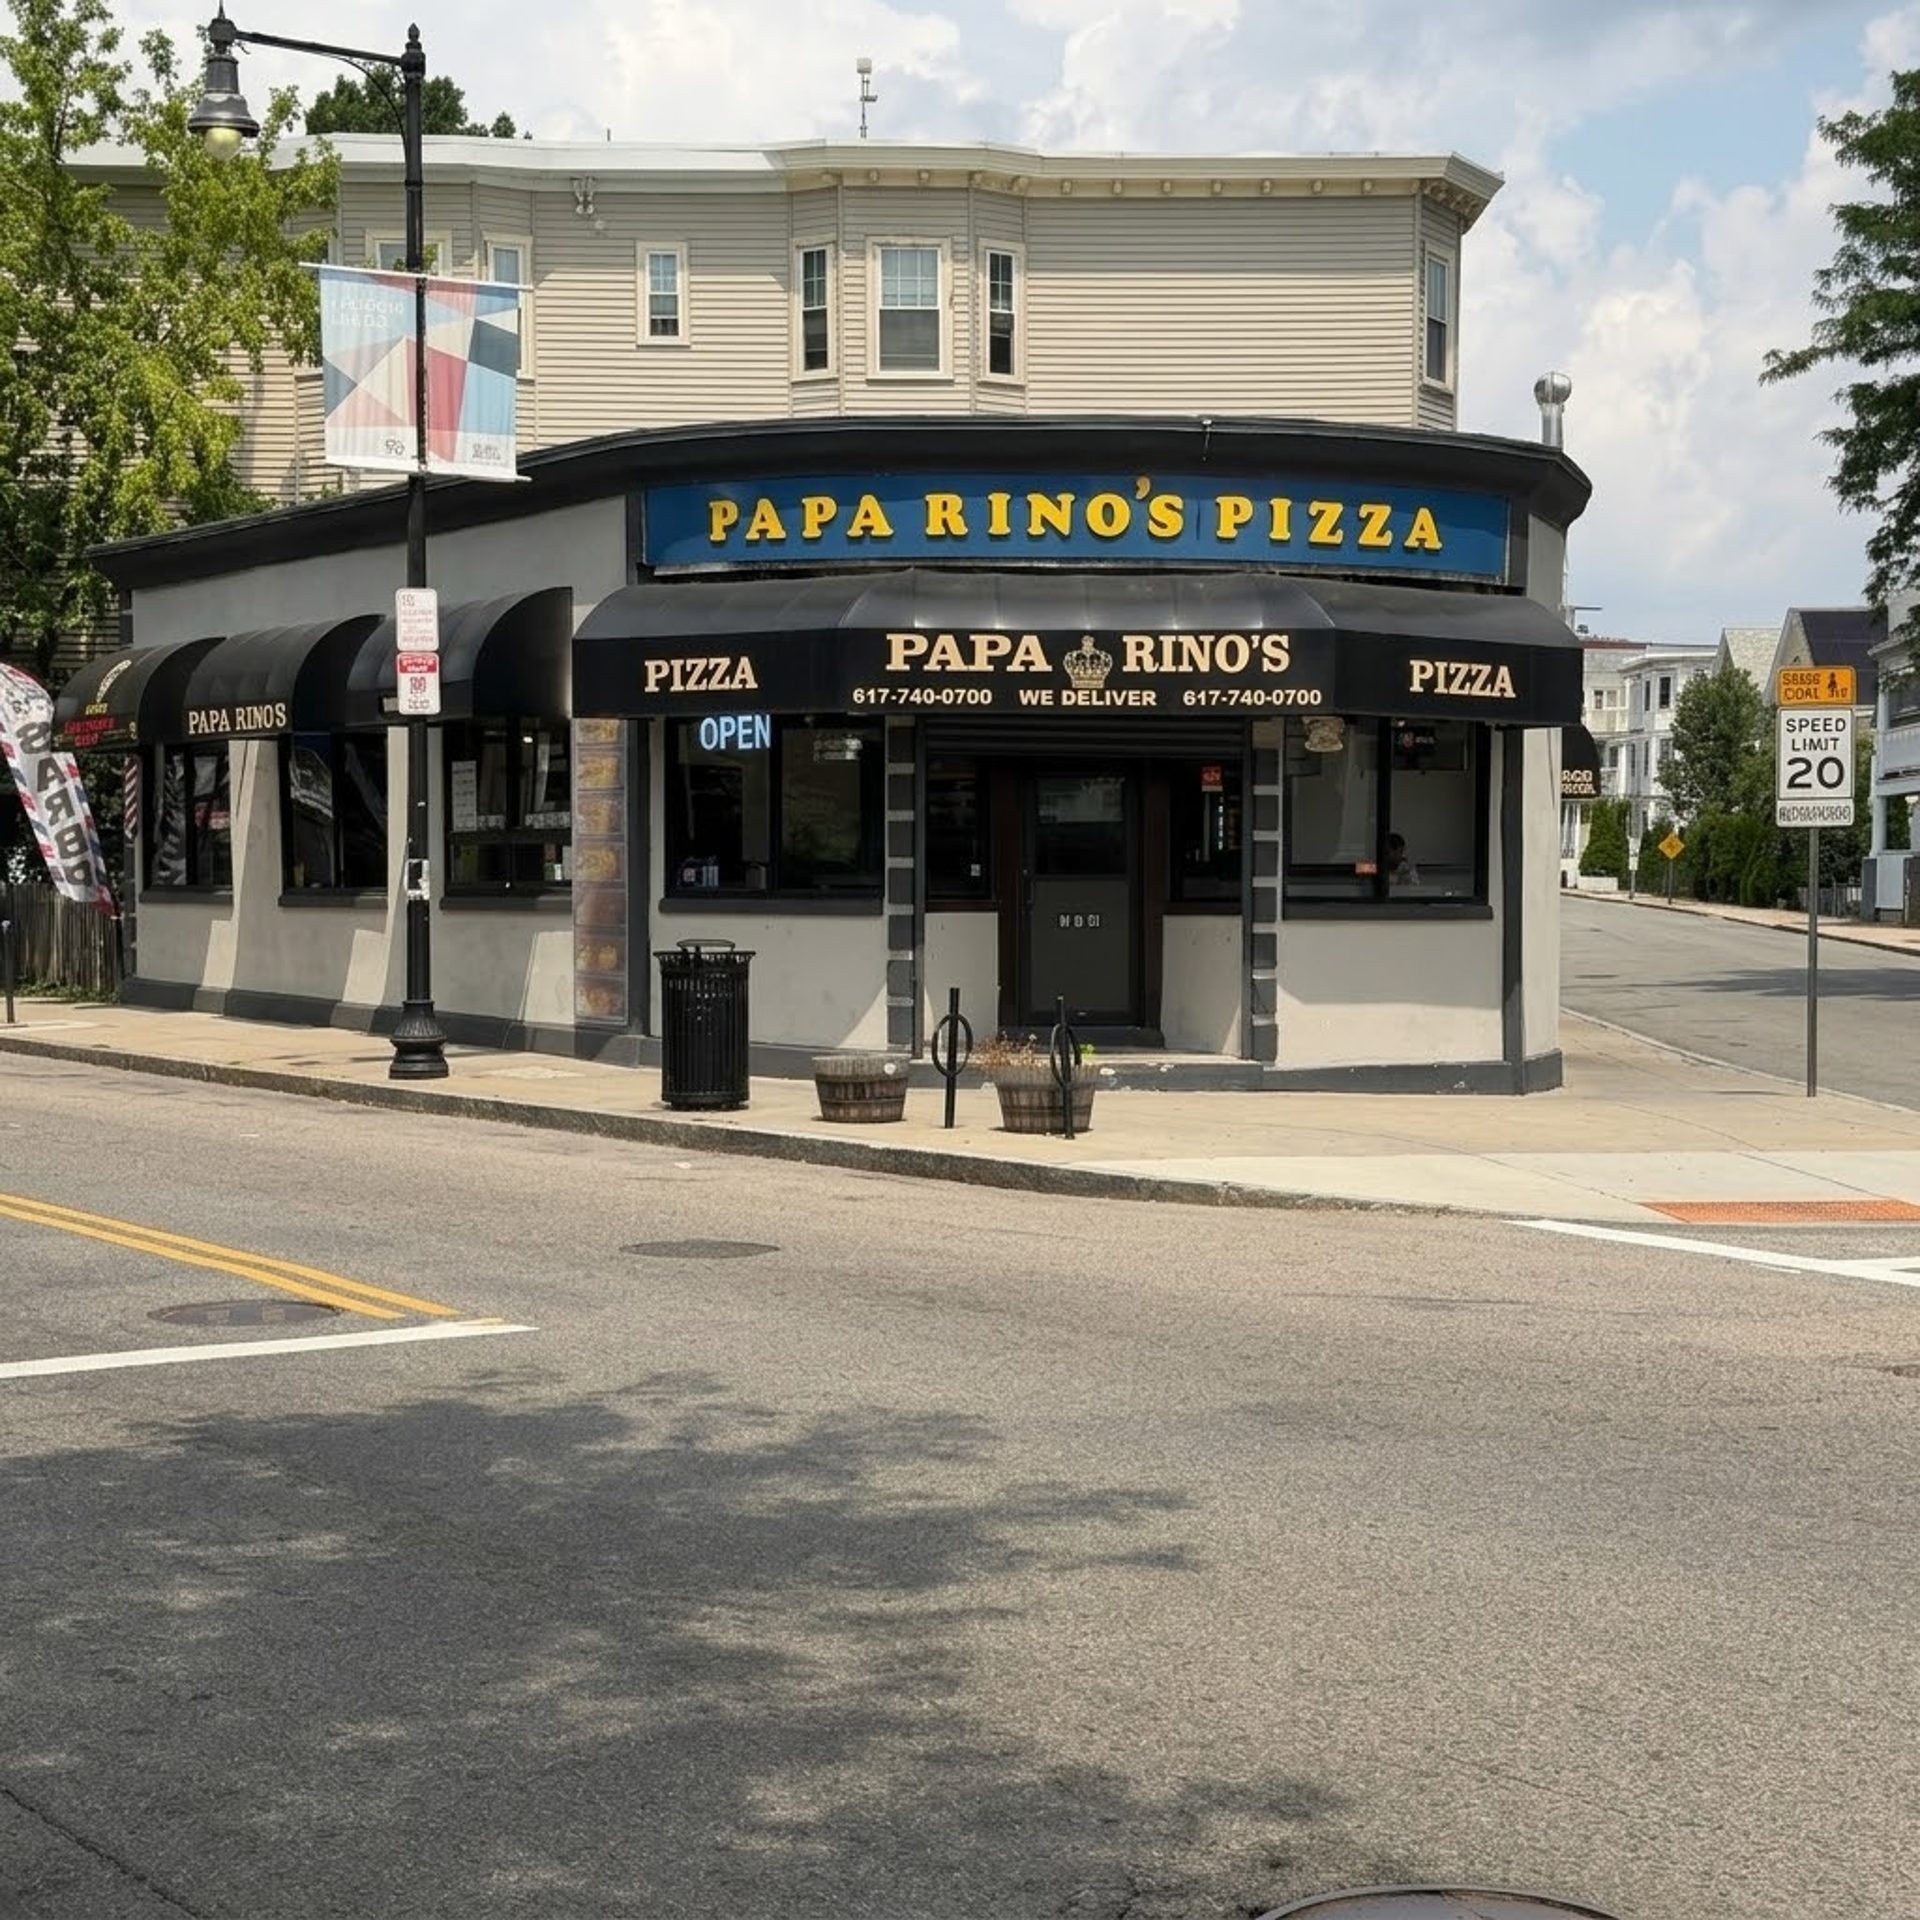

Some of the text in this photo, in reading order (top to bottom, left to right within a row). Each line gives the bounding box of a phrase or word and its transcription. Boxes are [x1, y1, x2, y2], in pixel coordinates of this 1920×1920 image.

[710, 477, 1442, 549] PAPA RINO'S PIZZA
[885, 633, 1291, 674] PAPA RINO'S
[644, 656, 759, 693] PIZZA
[1409, 659, 1517, 699] PIZZA
[852, 687, 1323, 706] 617-740-0700 WE DELIVER 617-740-0700
[188, 702, 286, 734] PAPA RINOS
[699, 714, 771, 751] OPEN
[1786, 717, 1846, 733] SPEED
[1791, 737, 1840, 752] LIMIT
[1786, 756, 1845, 790] 20
